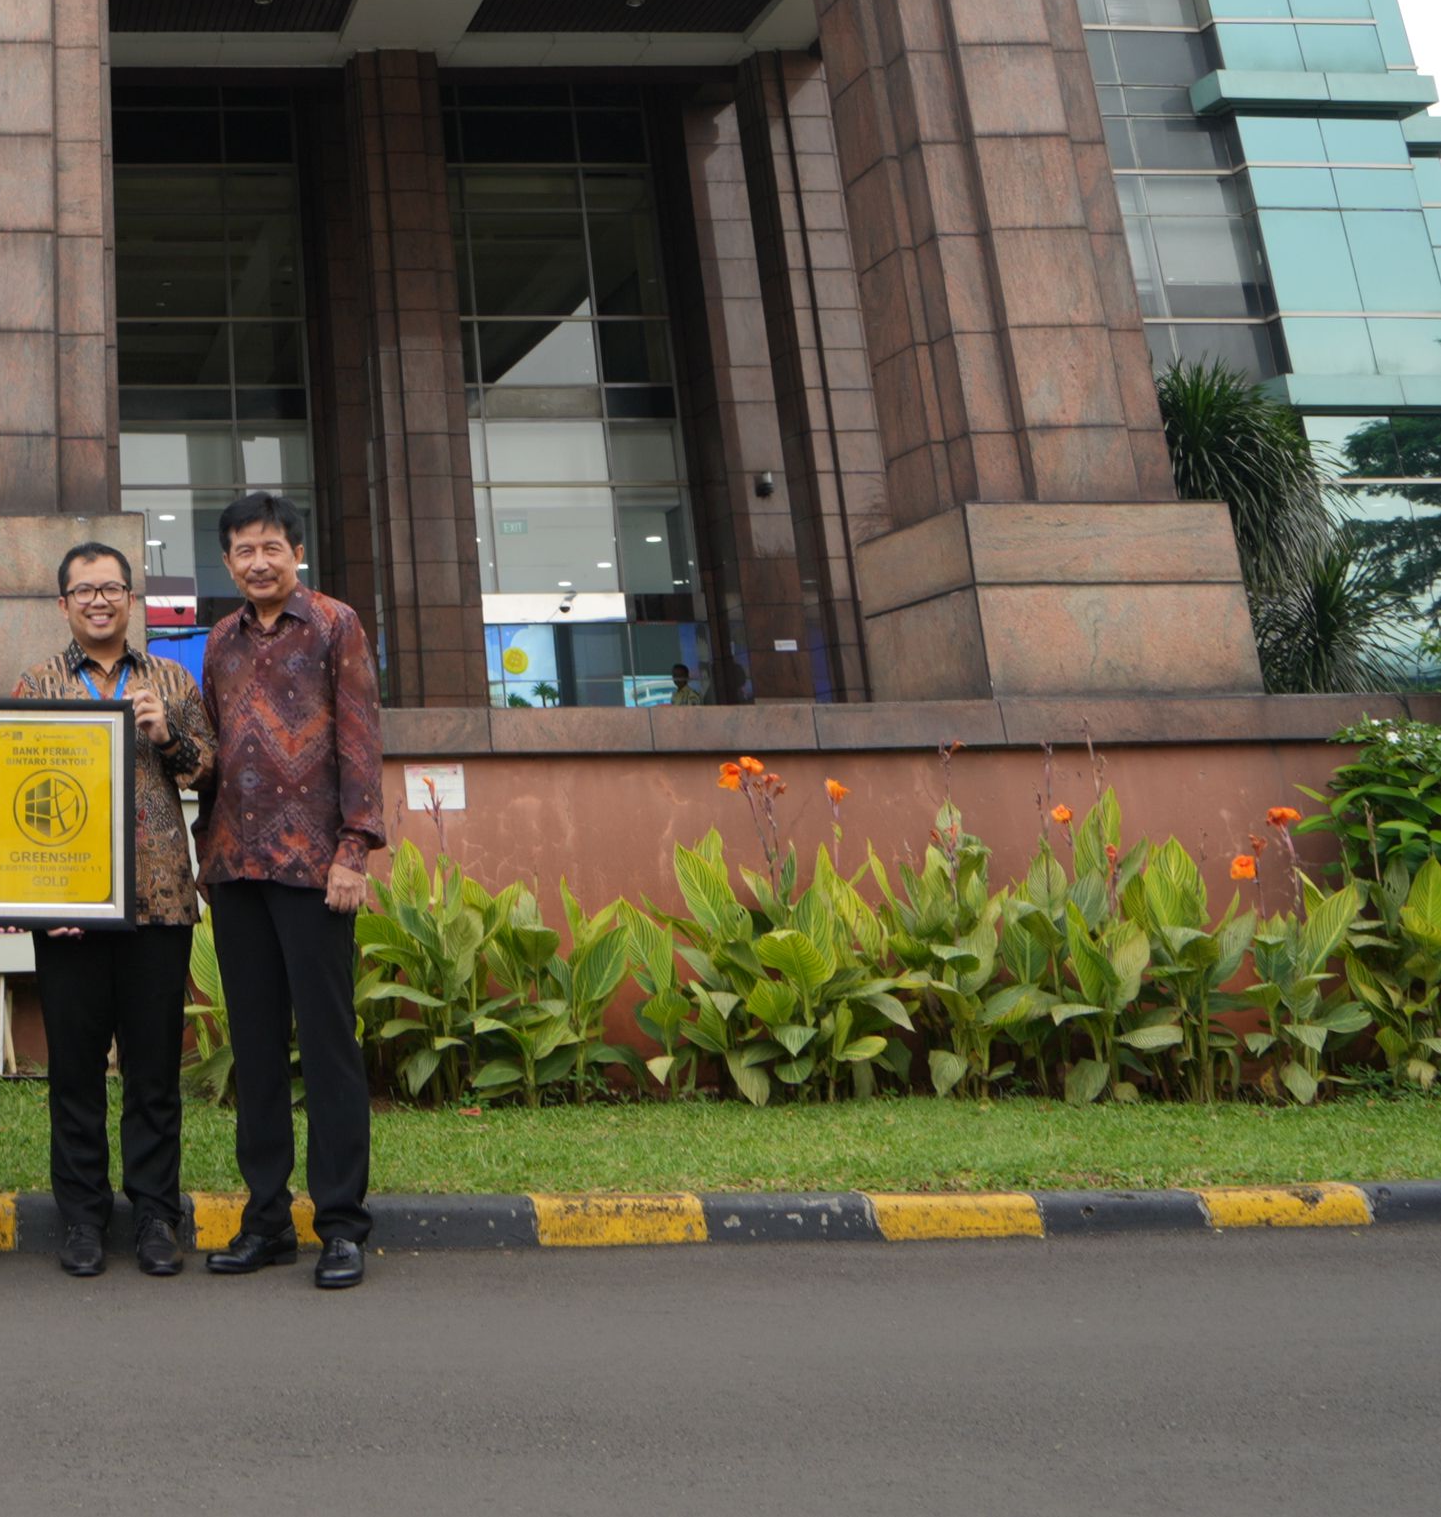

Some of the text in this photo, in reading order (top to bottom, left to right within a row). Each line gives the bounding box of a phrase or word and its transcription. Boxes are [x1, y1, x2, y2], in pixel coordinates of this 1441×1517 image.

[503, 522, 522, 533] EXIT
[12, 746, 89, 757] BANK PERMATA
[9, 851, 92, 863] GREENSHIP
[32, 875, 69, 887] GOLD
